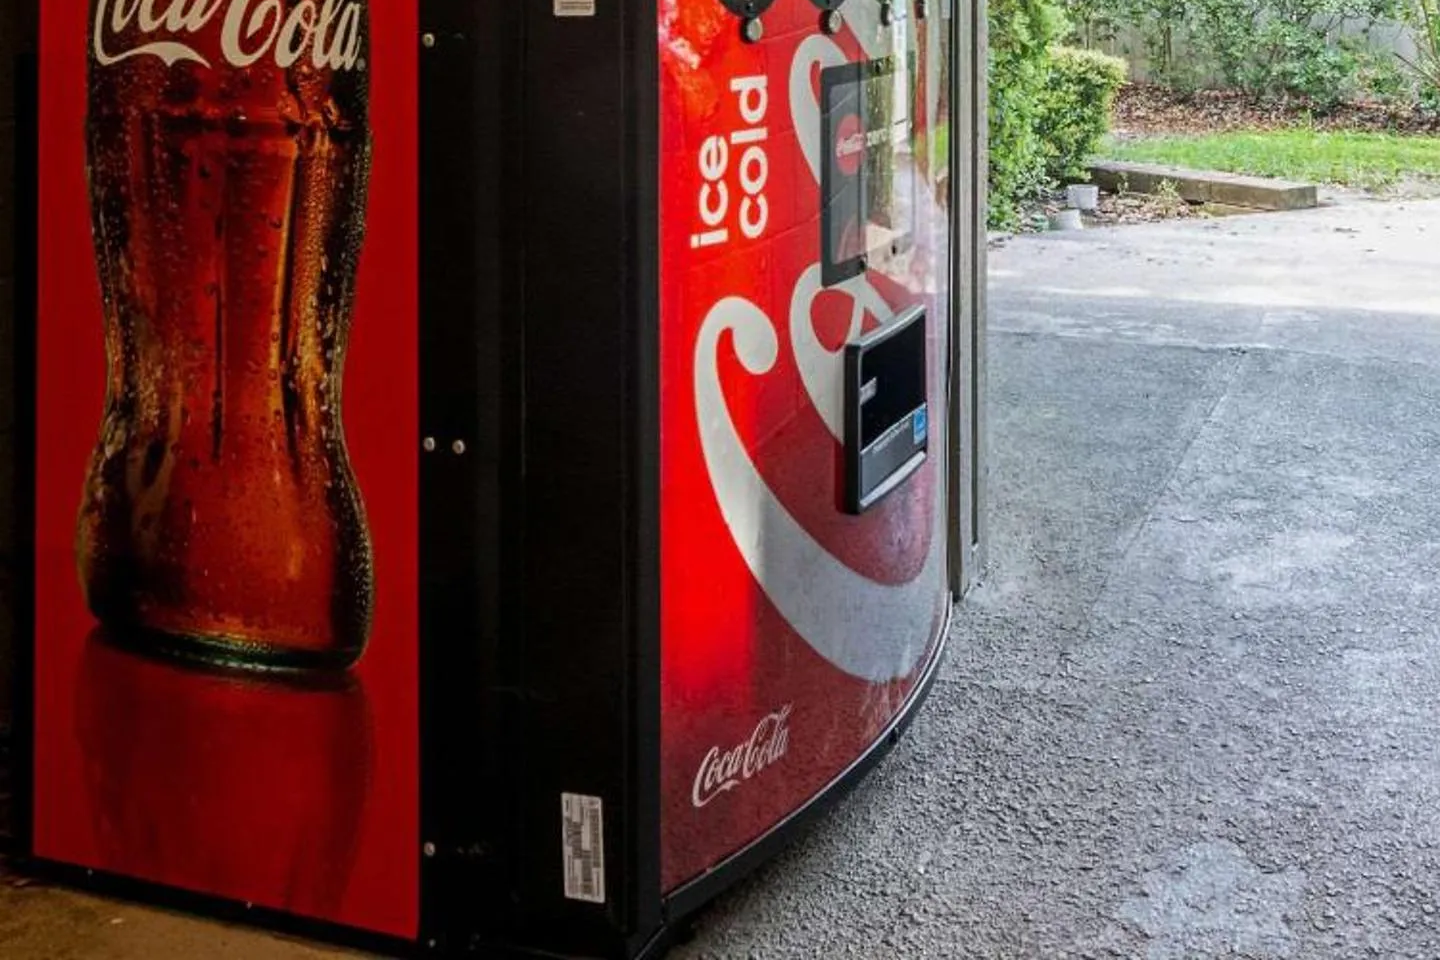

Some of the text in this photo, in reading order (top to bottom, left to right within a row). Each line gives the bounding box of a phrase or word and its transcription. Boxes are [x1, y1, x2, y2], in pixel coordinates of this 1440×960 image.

[690, 134, 729, 249] ice
[730, 74, 769, 238] cold
[692, 702, 794, 808] Coca-Cola
